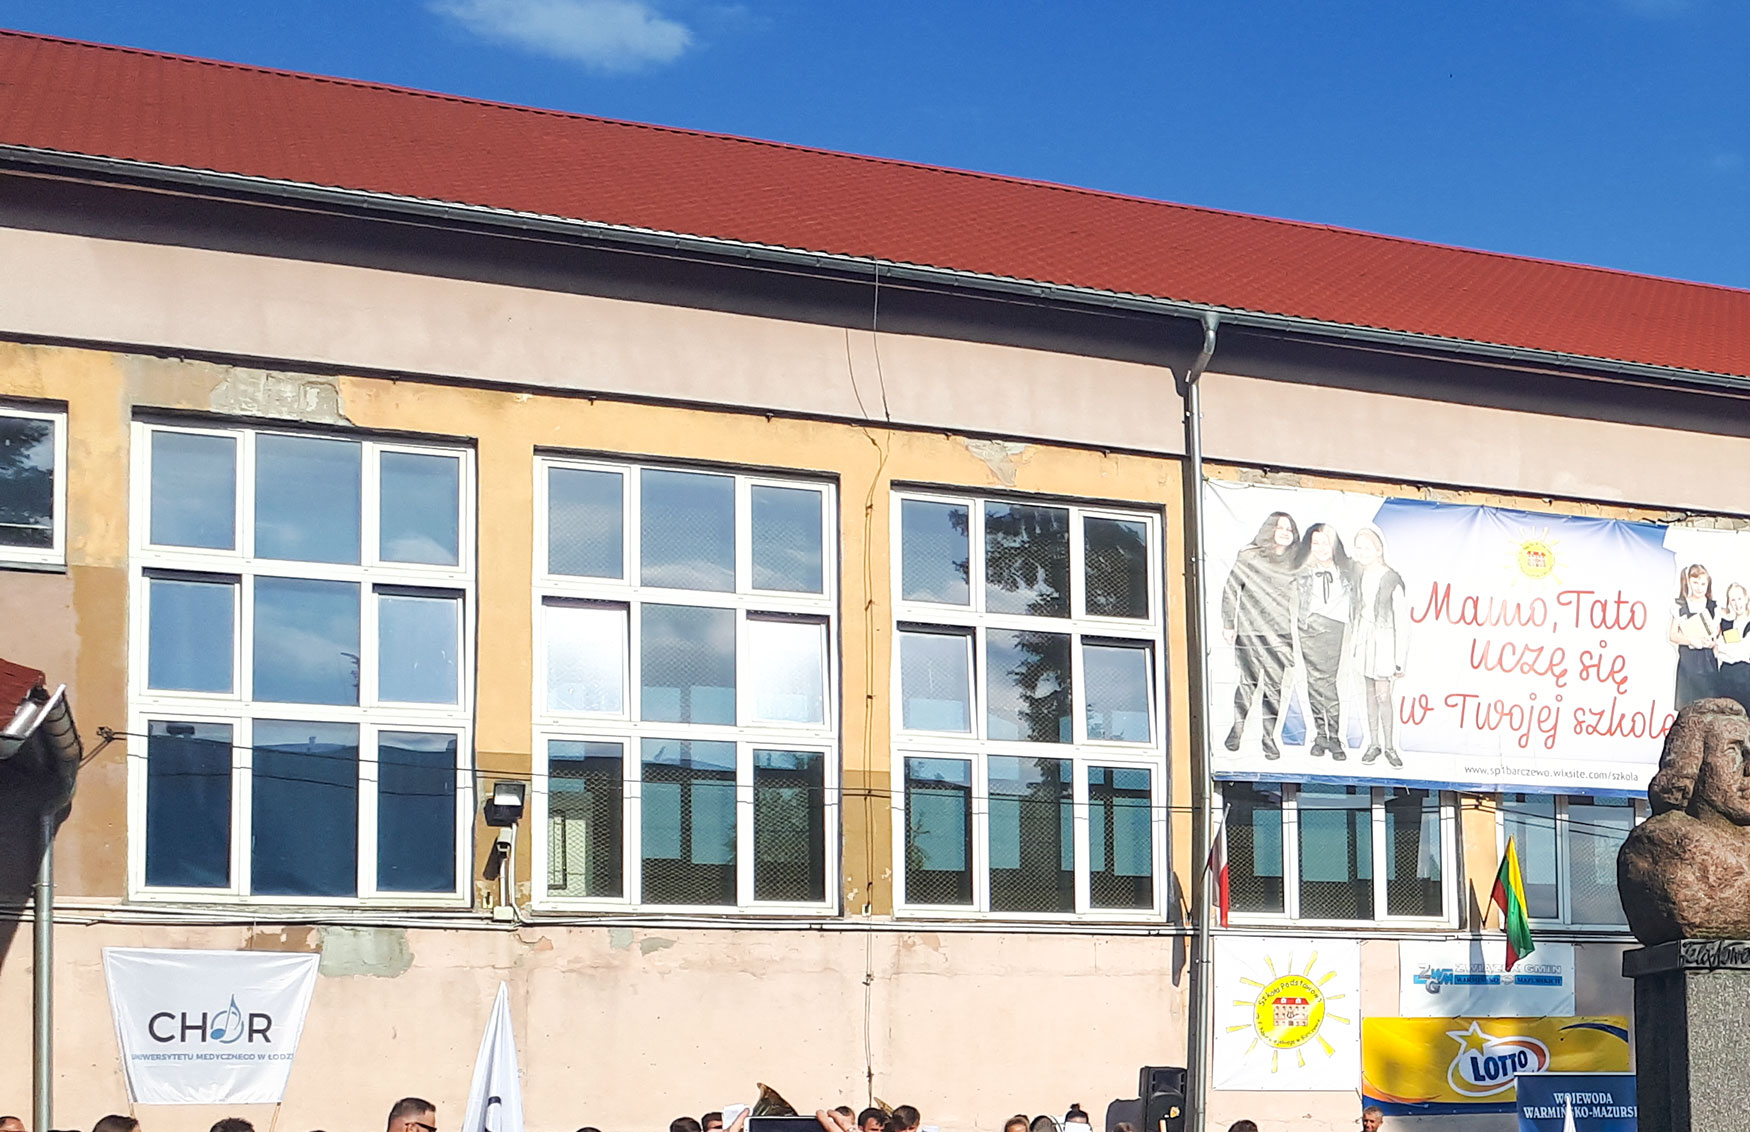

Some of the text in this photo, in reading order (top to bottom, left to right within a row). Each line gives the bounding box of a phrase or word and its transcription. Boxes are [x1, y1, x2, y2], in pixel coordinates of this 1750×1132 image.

[1410, 581, 1648, 633] Mamo, Tato
[1470, 638, 1628, 695] uczę się
[1400, 693, 1434, 726] w
[1444, 693, 1563, 750] Twojej
[1523, 964, 1562, 975] GMIN
[1470, 1050, 1529, 1082] LOTTO
[1553, 1092, 1614, 1105] WOJEWODA
